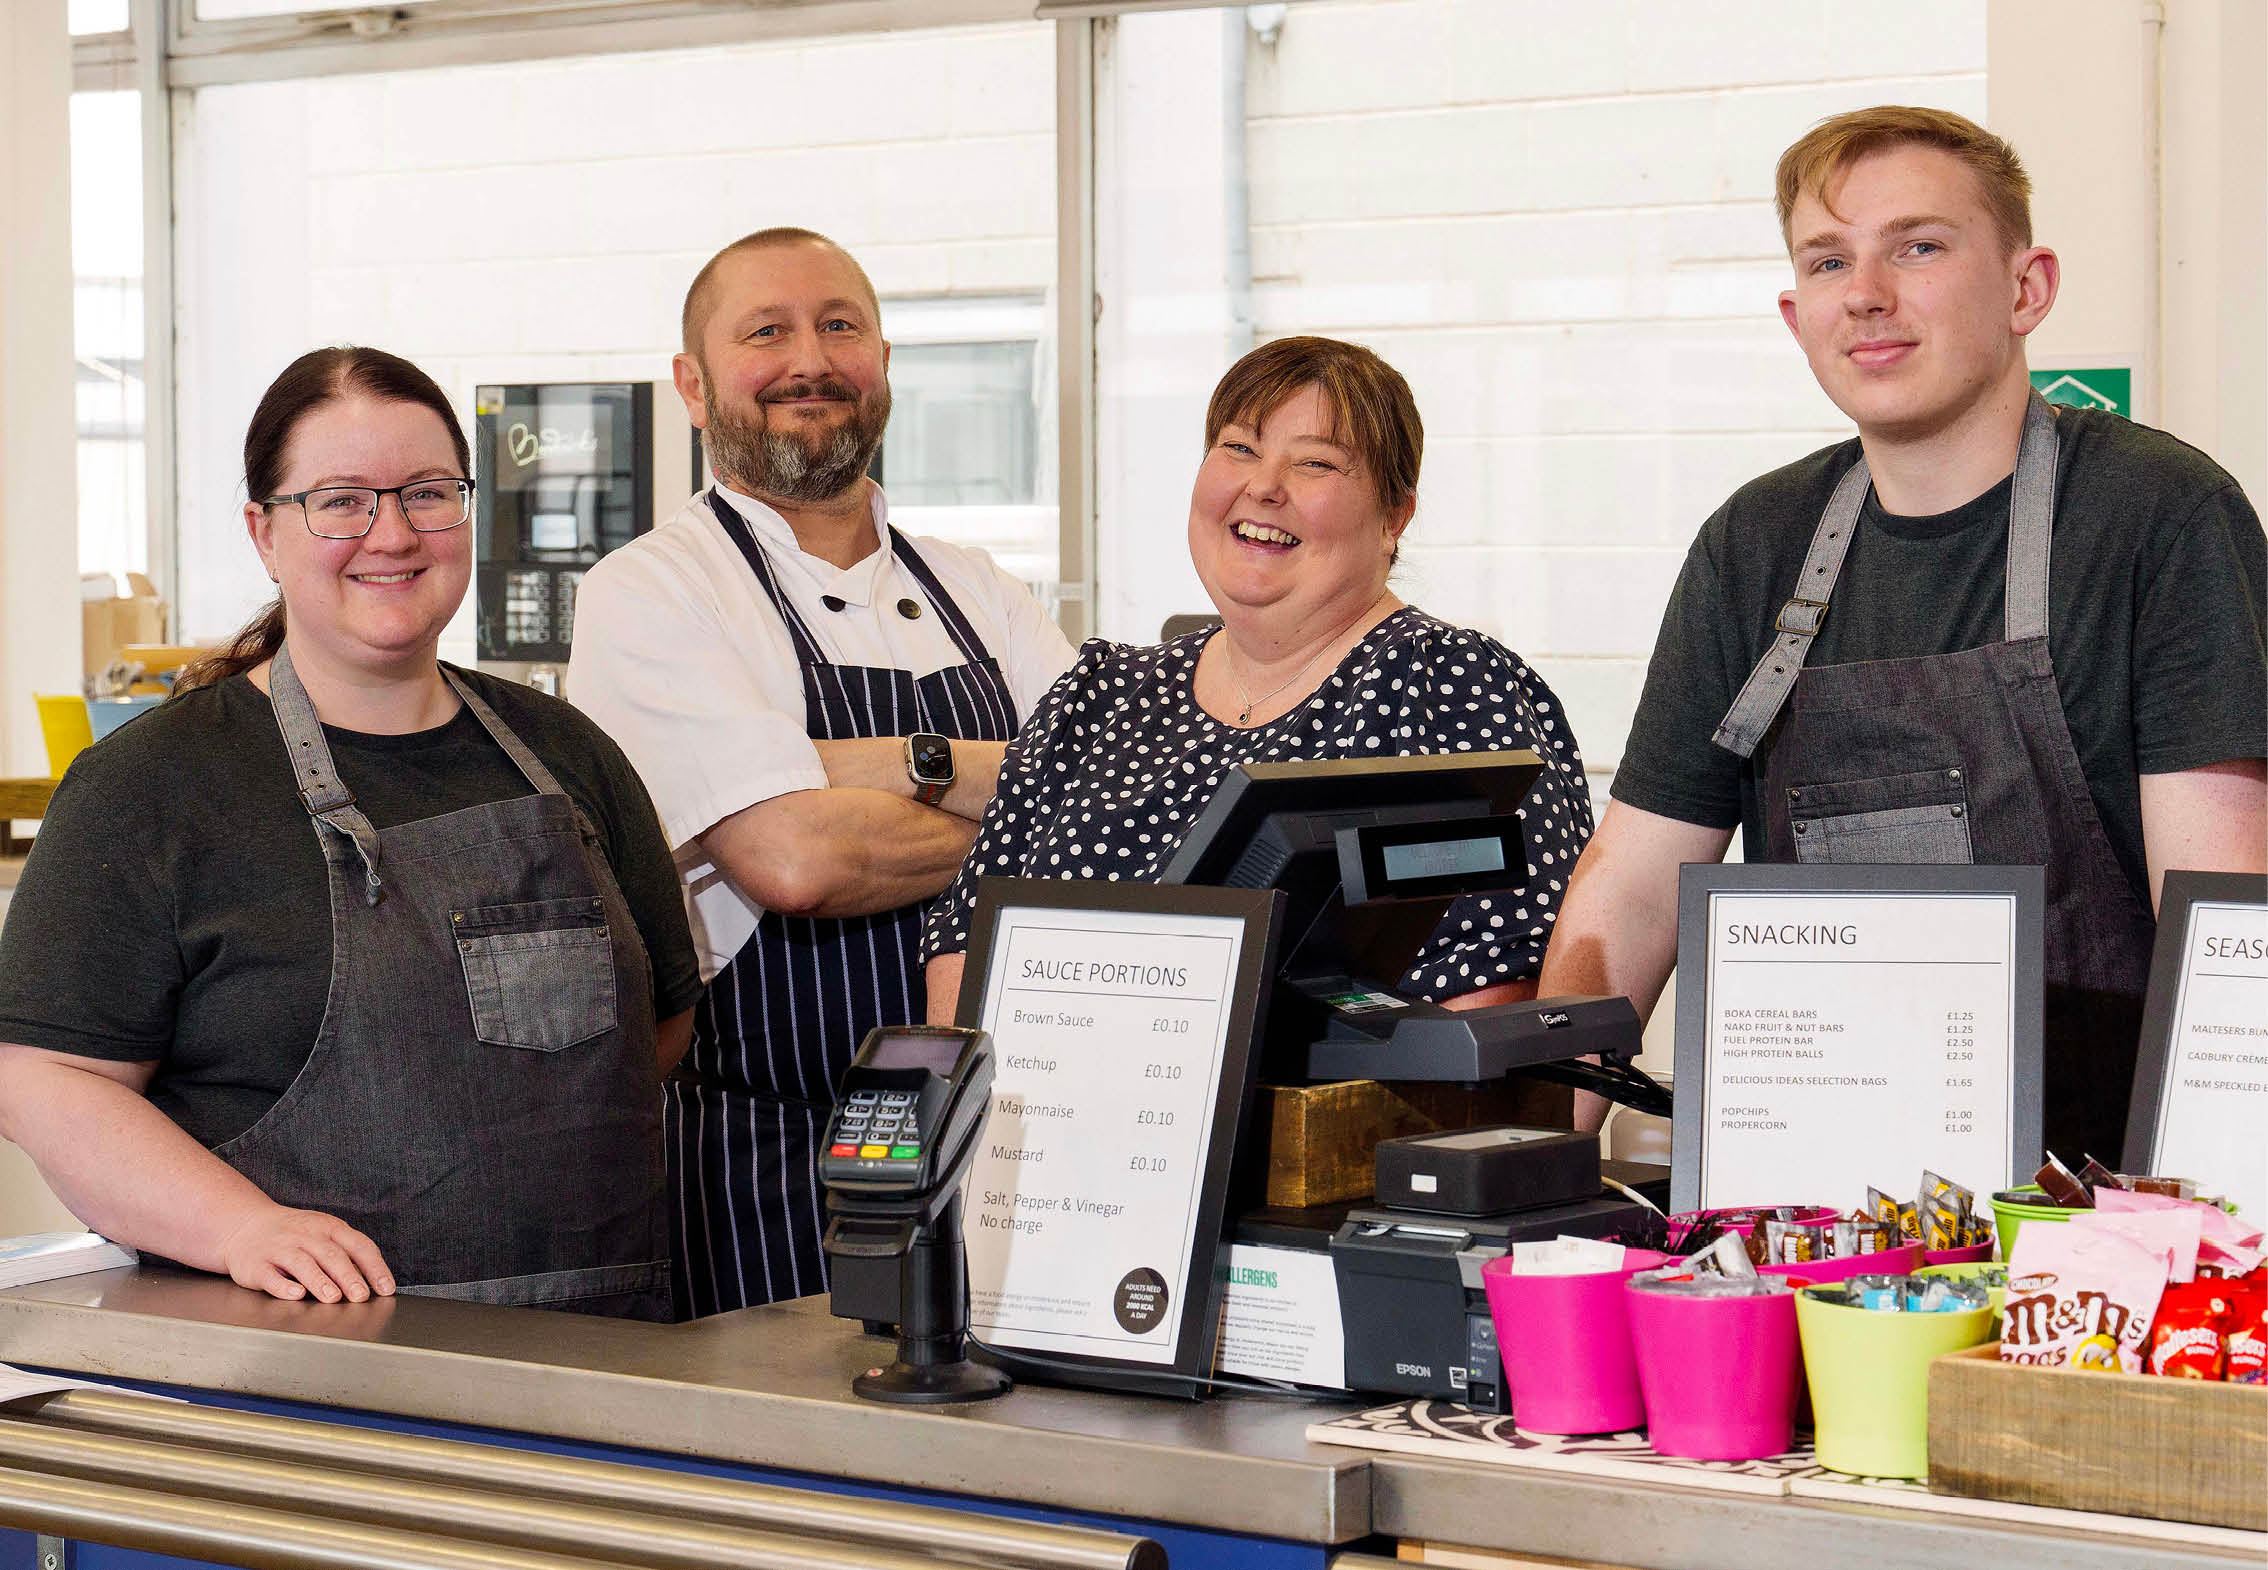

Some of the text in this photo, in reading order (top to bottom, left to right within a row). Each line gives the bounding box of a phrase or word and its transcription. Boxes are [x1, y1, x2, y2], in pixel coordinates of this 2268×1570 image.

[1728, 925, 1857, 945] SNACKING
[2204, 937, 2268, 959] SEAS
[1022, 959, 1187, 987] SAUCE PORTIONS
[1724, 1009, 1974, 1021] BOKA CEREAL BARS £1.25
[1014, 1010, 1188, 1034] Brown Sauce £0.10
[1724, 1023, 1974, 1034] NAKD FRUIT & NUT BARS £1.25
[2191, 1024, 2246, 1036] MALTESERS
[1724, 1036, 1974, 1047] FUEL PROTEIN BAR £2.50
[1723, 1049, 1974, 1061] HIGH PROTEIN BALLS £2.50
[2187, 1052, 2268, 1065] CADBURY CREME
[1006, 1056, 1182, 1080] Ketchup £0.10
[1722, 1075, 1973, 1087] DELICIOUS IDEAS SELECTION BAGS £1.65
[2184, 1079, 2211, 1089] M&M
[2214, 1080, 2261, 1092] SPECKLED
[999, 1100, 1174, 1126] Mayonnaise £0.10
[1721, 1107, 1973, 1119] POPCHIPS £1.00
[1721, 1120, 1973, 1133] PROPERCORN £1.00
[991, 1145, 1167, 1172] Mustard £0.10
[983, 1191, 1125, 1218] Salt, Pepper & Vinegar
[980, 1214, 1043, 1235] No charge
[1125, 1284, 1162, 1293] ADULTS NEED
[1130, 1293, 1154, 1302] AROUND
[1136, 1312, 1148, 1320] DAY
[1396, 1363, 1431, 1378] EPSON
